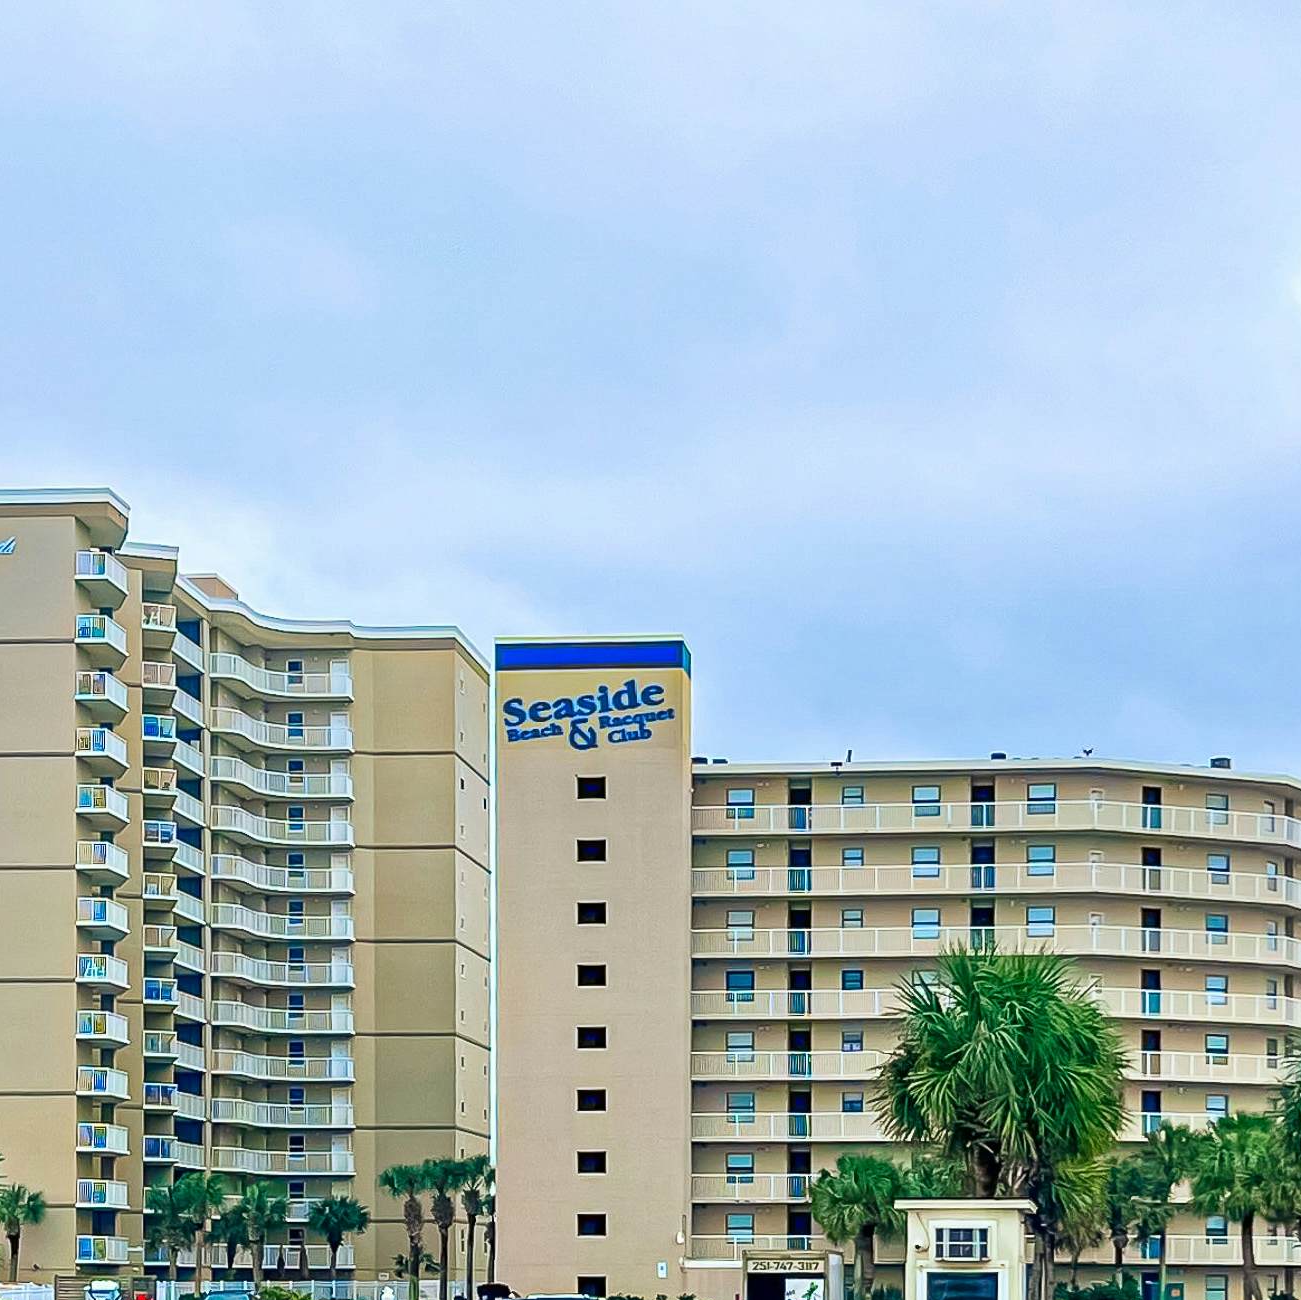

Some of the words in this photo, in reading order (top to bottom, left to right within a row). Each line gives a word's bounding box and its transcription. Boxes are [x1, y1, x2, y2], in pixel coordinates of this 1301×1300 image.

[503, 679, 665, 727] Seaside
[506, 723, 564, 742] Beach
[569, 718, 598, 750] &
[598, 708, 675, 732] Racquet
[608, 726, 652, 743] Club
